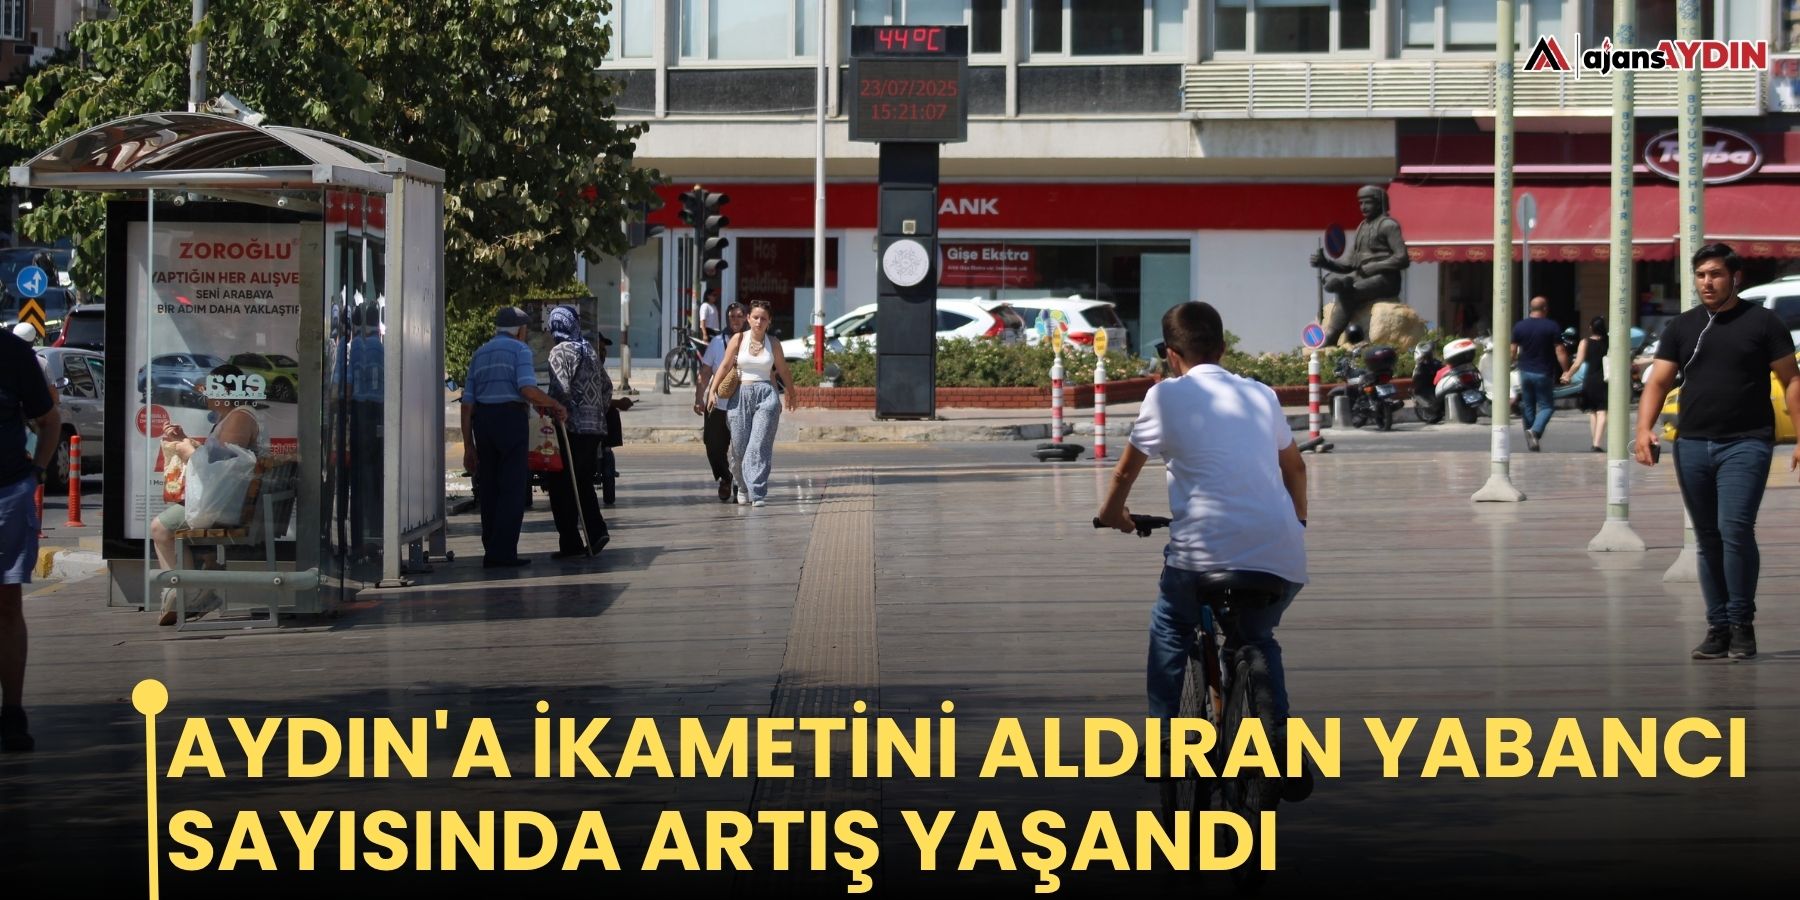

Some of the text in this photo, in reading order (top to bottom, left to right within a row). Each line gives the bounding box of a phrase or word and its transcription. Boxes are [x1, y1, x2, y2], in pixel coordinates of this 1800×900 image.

[861, 80, 958, 97] 23/07/2025
[871, 103, 947, 120] 15:21:07
[938, 198, 999, 215] ANK
[178, 238, 292, 260] ZOROĞLU
[947, 247, 1029, 264] Gişe Ekstra
[219, 272, 246, 284] HER
[250, 272, 299, 287] ALIŞVE
[196, 287, 273, 299] SENİ ARABAYA
[157, 302, 175, 314] BİR
[177, 304, 206, 314] ADIM
[209, 304, 241, 314] DAHA
